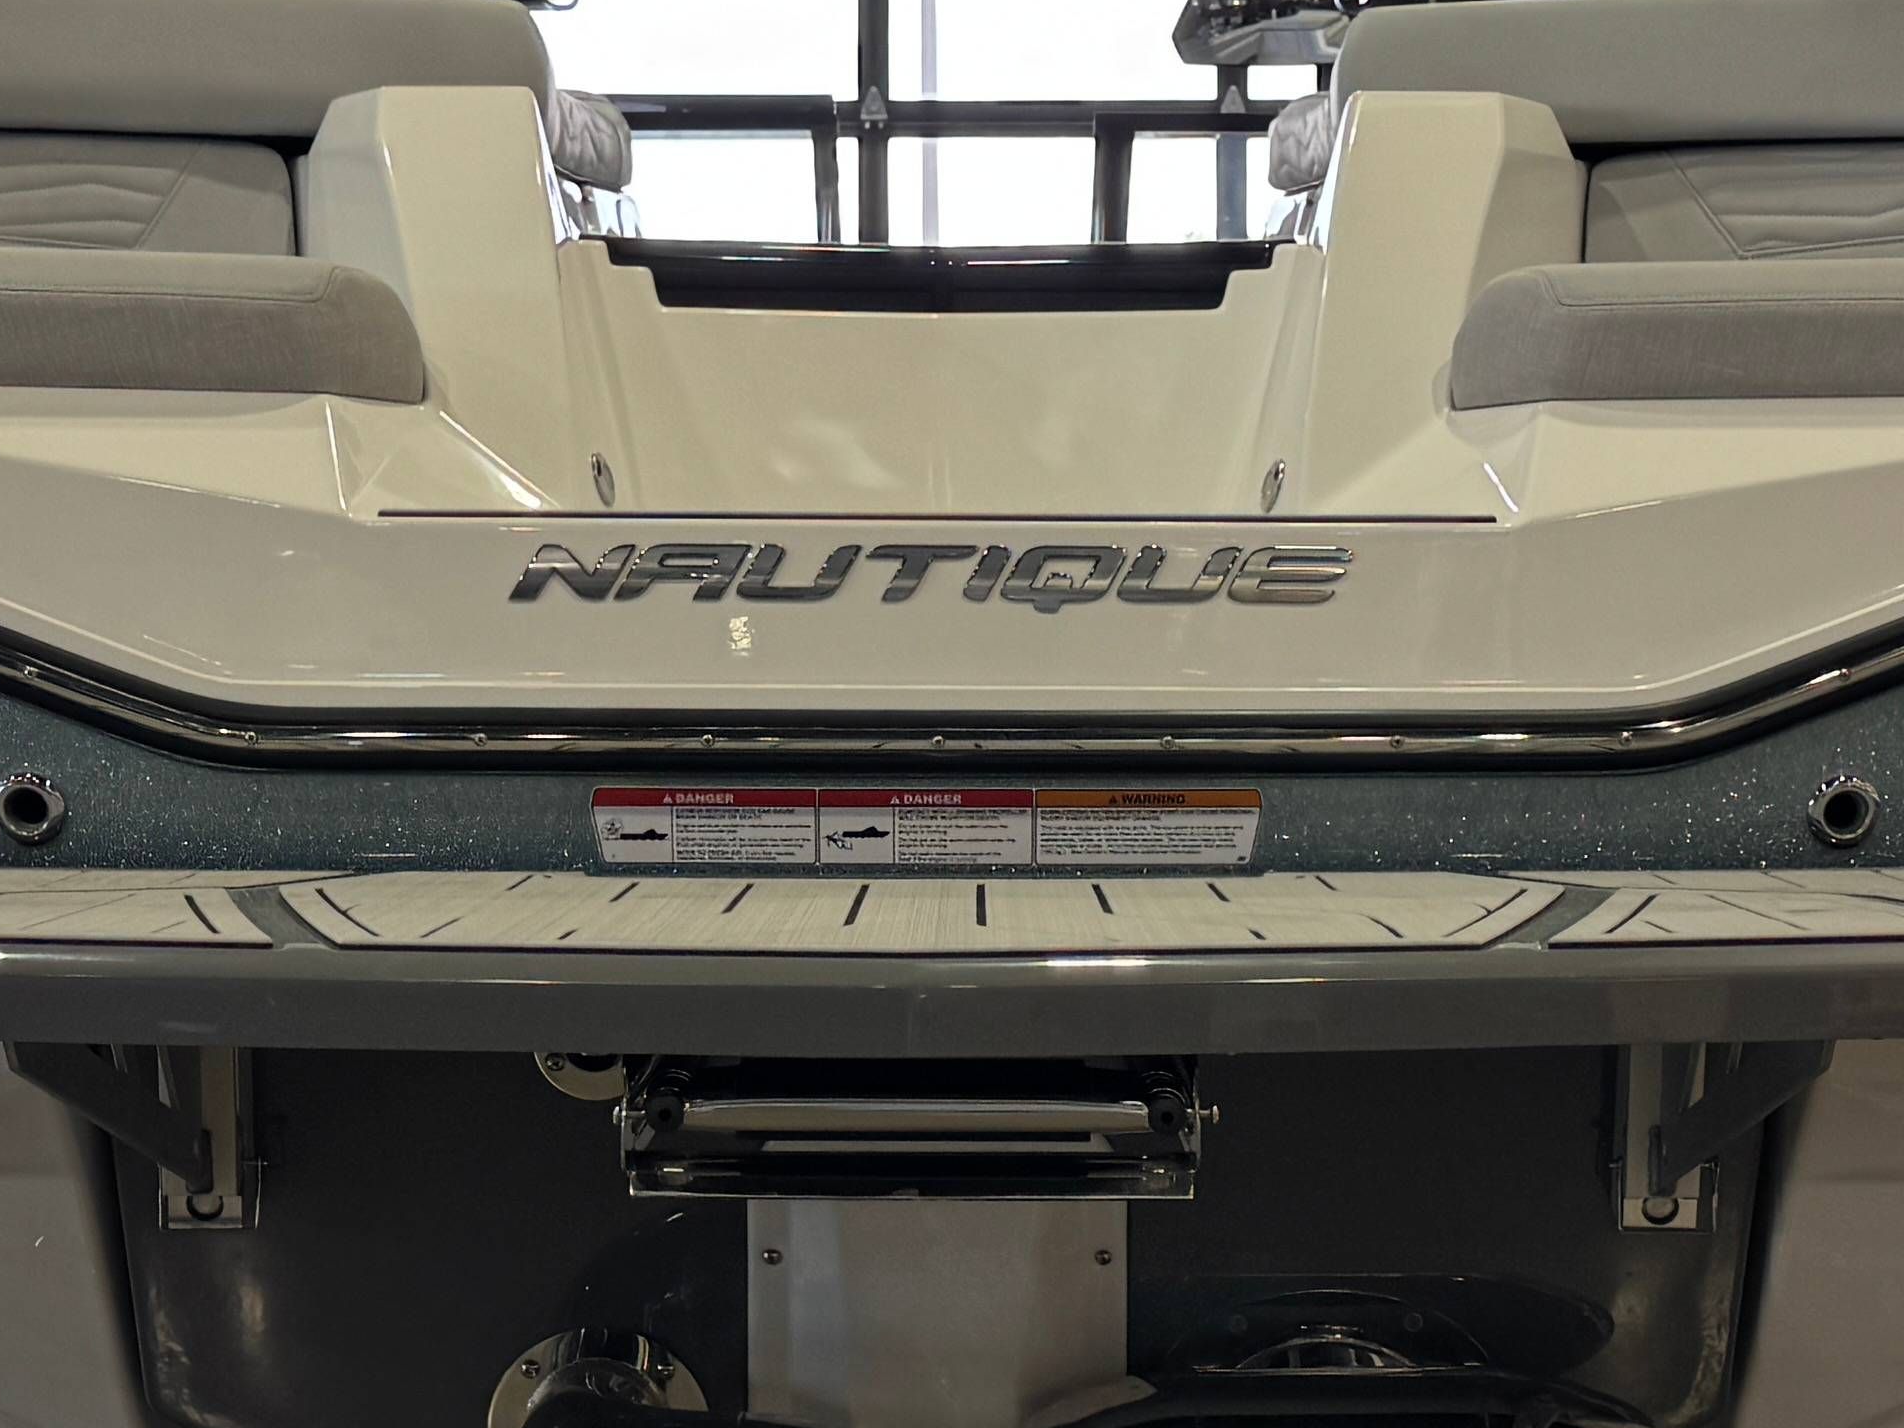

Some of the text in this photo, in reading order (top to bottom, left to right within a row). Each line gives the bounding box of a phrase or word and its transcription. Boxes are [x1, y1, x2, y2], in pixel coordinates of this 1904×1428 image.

[508, 541, 1355, 615] NAUTIQUE
[675, 792, 736, 805] DANGER
[903, 793, 963, 806] DANGER
[1121, 792, 1187, 805] WARNING
